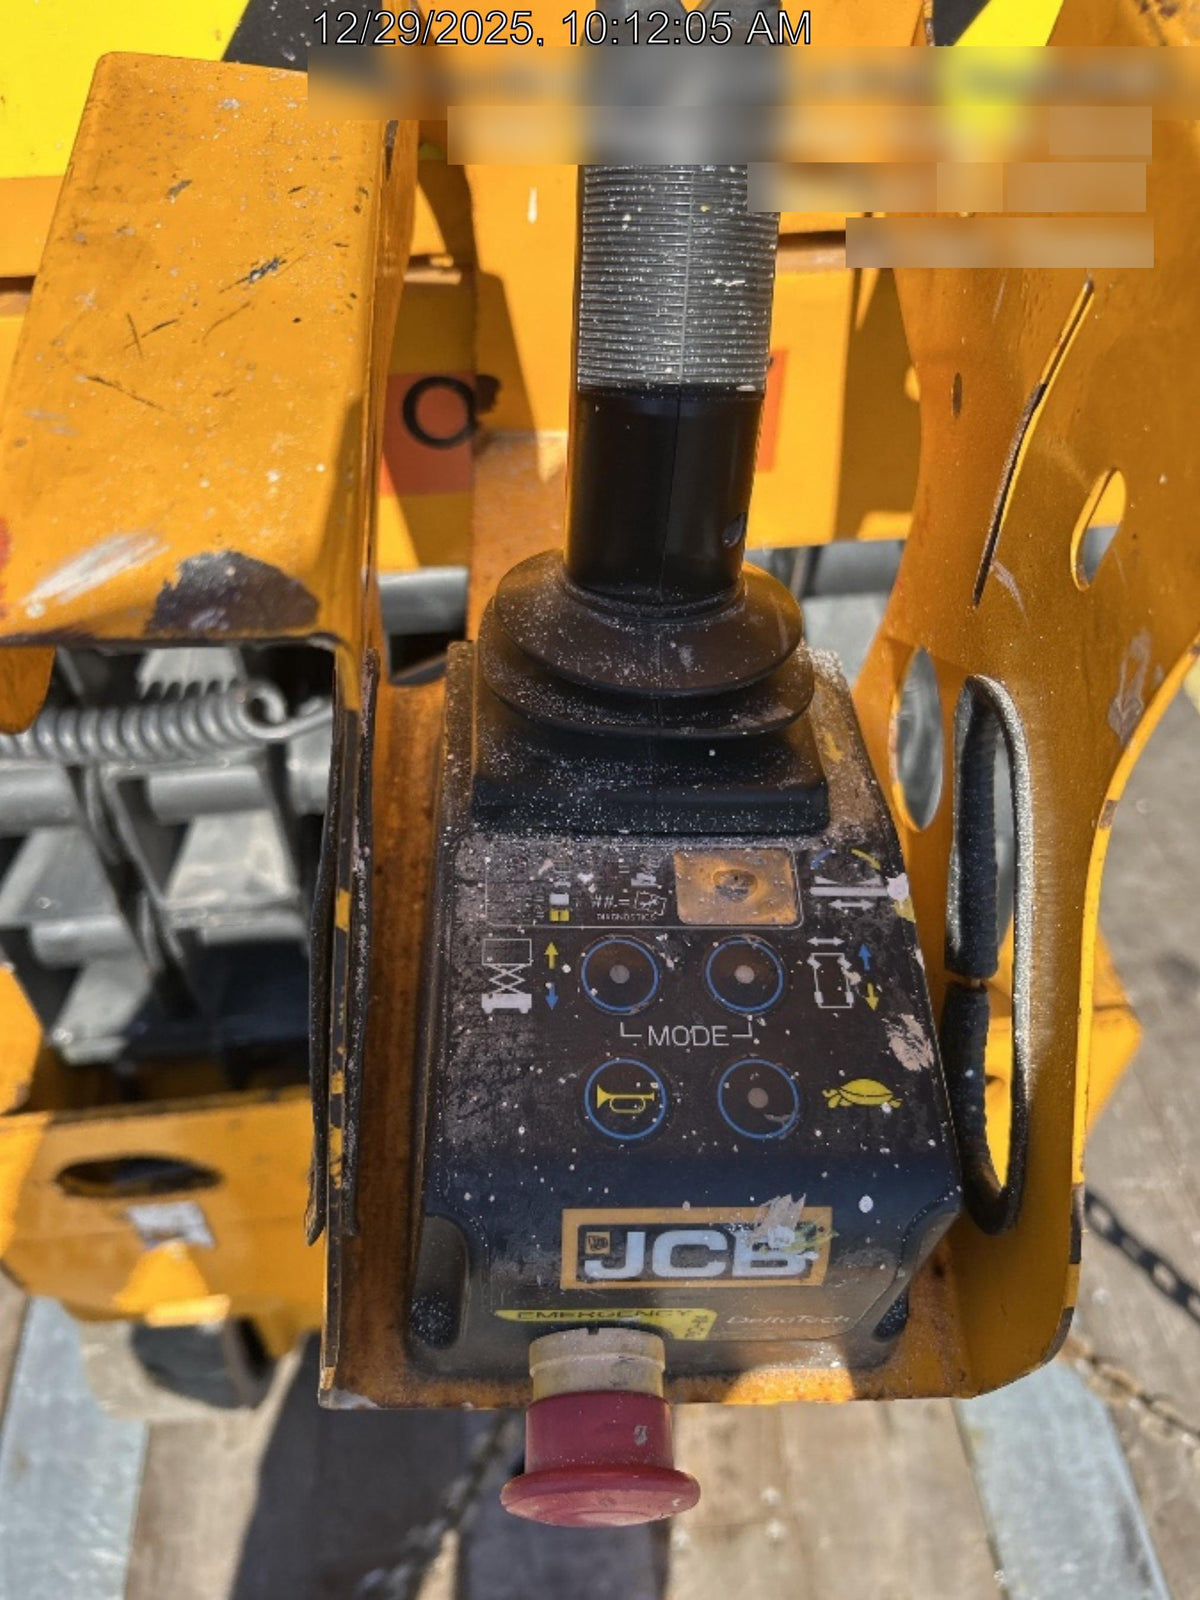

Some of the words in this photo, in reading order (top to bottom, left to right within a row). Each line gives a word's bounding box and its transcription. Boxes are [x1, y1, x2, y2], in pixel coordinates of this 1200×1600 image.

[648, 1025, 730, 1046] MODE
[584, 1229, 809, 1279] JCB
[517, 1309, 693, 1319] EMERGENCY
